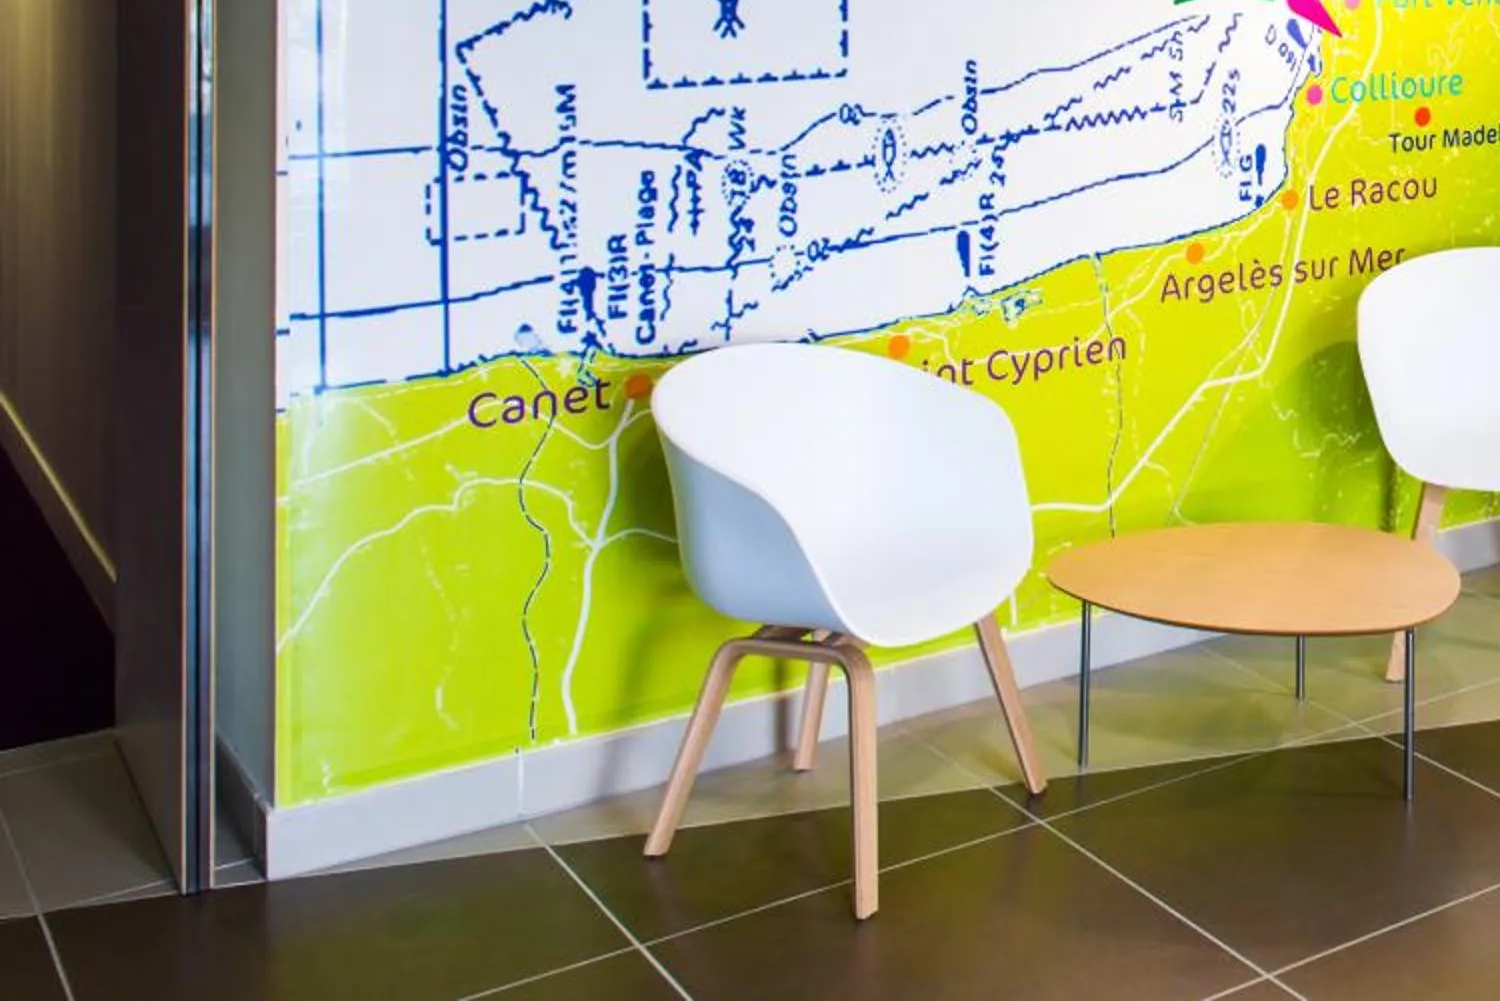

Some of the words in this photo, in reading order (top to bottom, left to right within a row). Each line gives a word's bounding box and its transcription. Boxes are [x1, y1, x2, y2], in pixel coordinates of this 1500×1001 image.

[1331, 72, 1464, 104] Collioure
[1388, 130, 1438, 154] Tour
[1308, 182, 1342, 212] Le
[1349, 176, 1439, 207] Racou
[1160, 256, 1285, 304] Argelès
[1294, 254, 1341, 285] sur
[1348, 246, 1407, 277] Mer
[985, 335, 1129, 387] Cyprien
[466, 378, 613, 430] Canet
